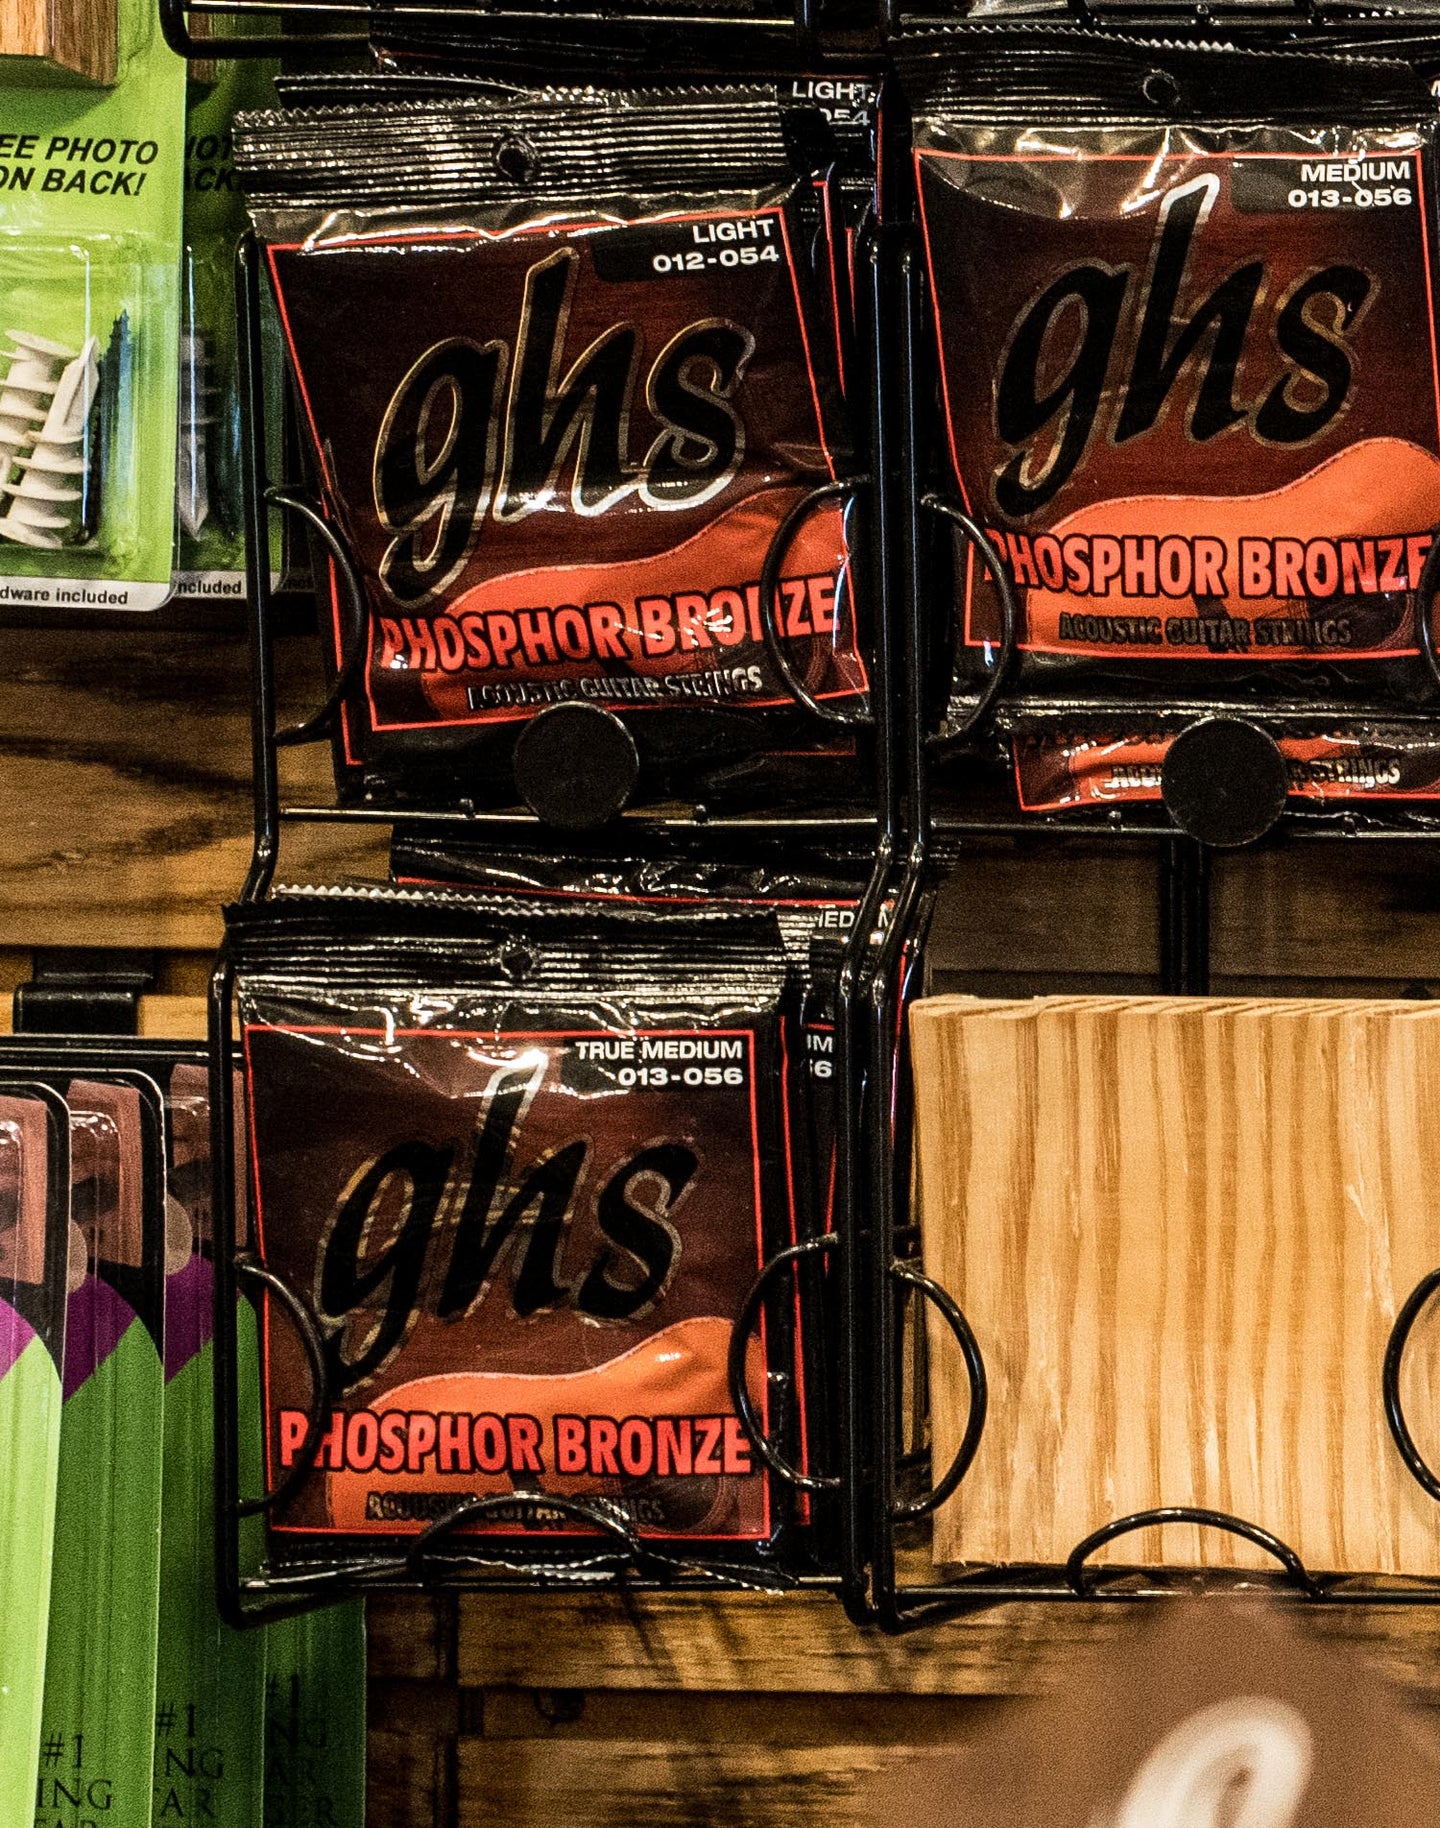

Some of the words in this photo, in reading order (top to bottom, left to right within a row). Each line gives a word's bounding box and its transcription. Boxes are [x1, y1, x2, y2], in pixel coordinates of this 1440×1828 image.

[45, 136, 159, 165] PHOTO
[41, 168, 147, 196] BACK!
[1300, 161, 1410, 182] MEDIUM
[1288, 188, 1412, 208] 013-056
[692, 219, 774, 243] LIGHT
[653, 245, 779, 272] 012-054
[992, 173, 1382, 517] ghs
[374, 247, 758, 604] ghs
[983, 528, 1228, 597] PHOSPHOR
[56, 588, 128, 605] included
[380, 601, 630, 671] PHOSPHOR
[575, 1041, 634, 1060] TRUE
[651, 1041, 743, 1060] MEDIUM
[618, 1067, 743, 1086] 013-056
[313, 1052, 700, 1395] ghs
[280, 1409, 543, 1474] PHOSPHOR
[555, 1412, 752, 1477] BRONZE
[44, 1732, 85, 1769] #1
